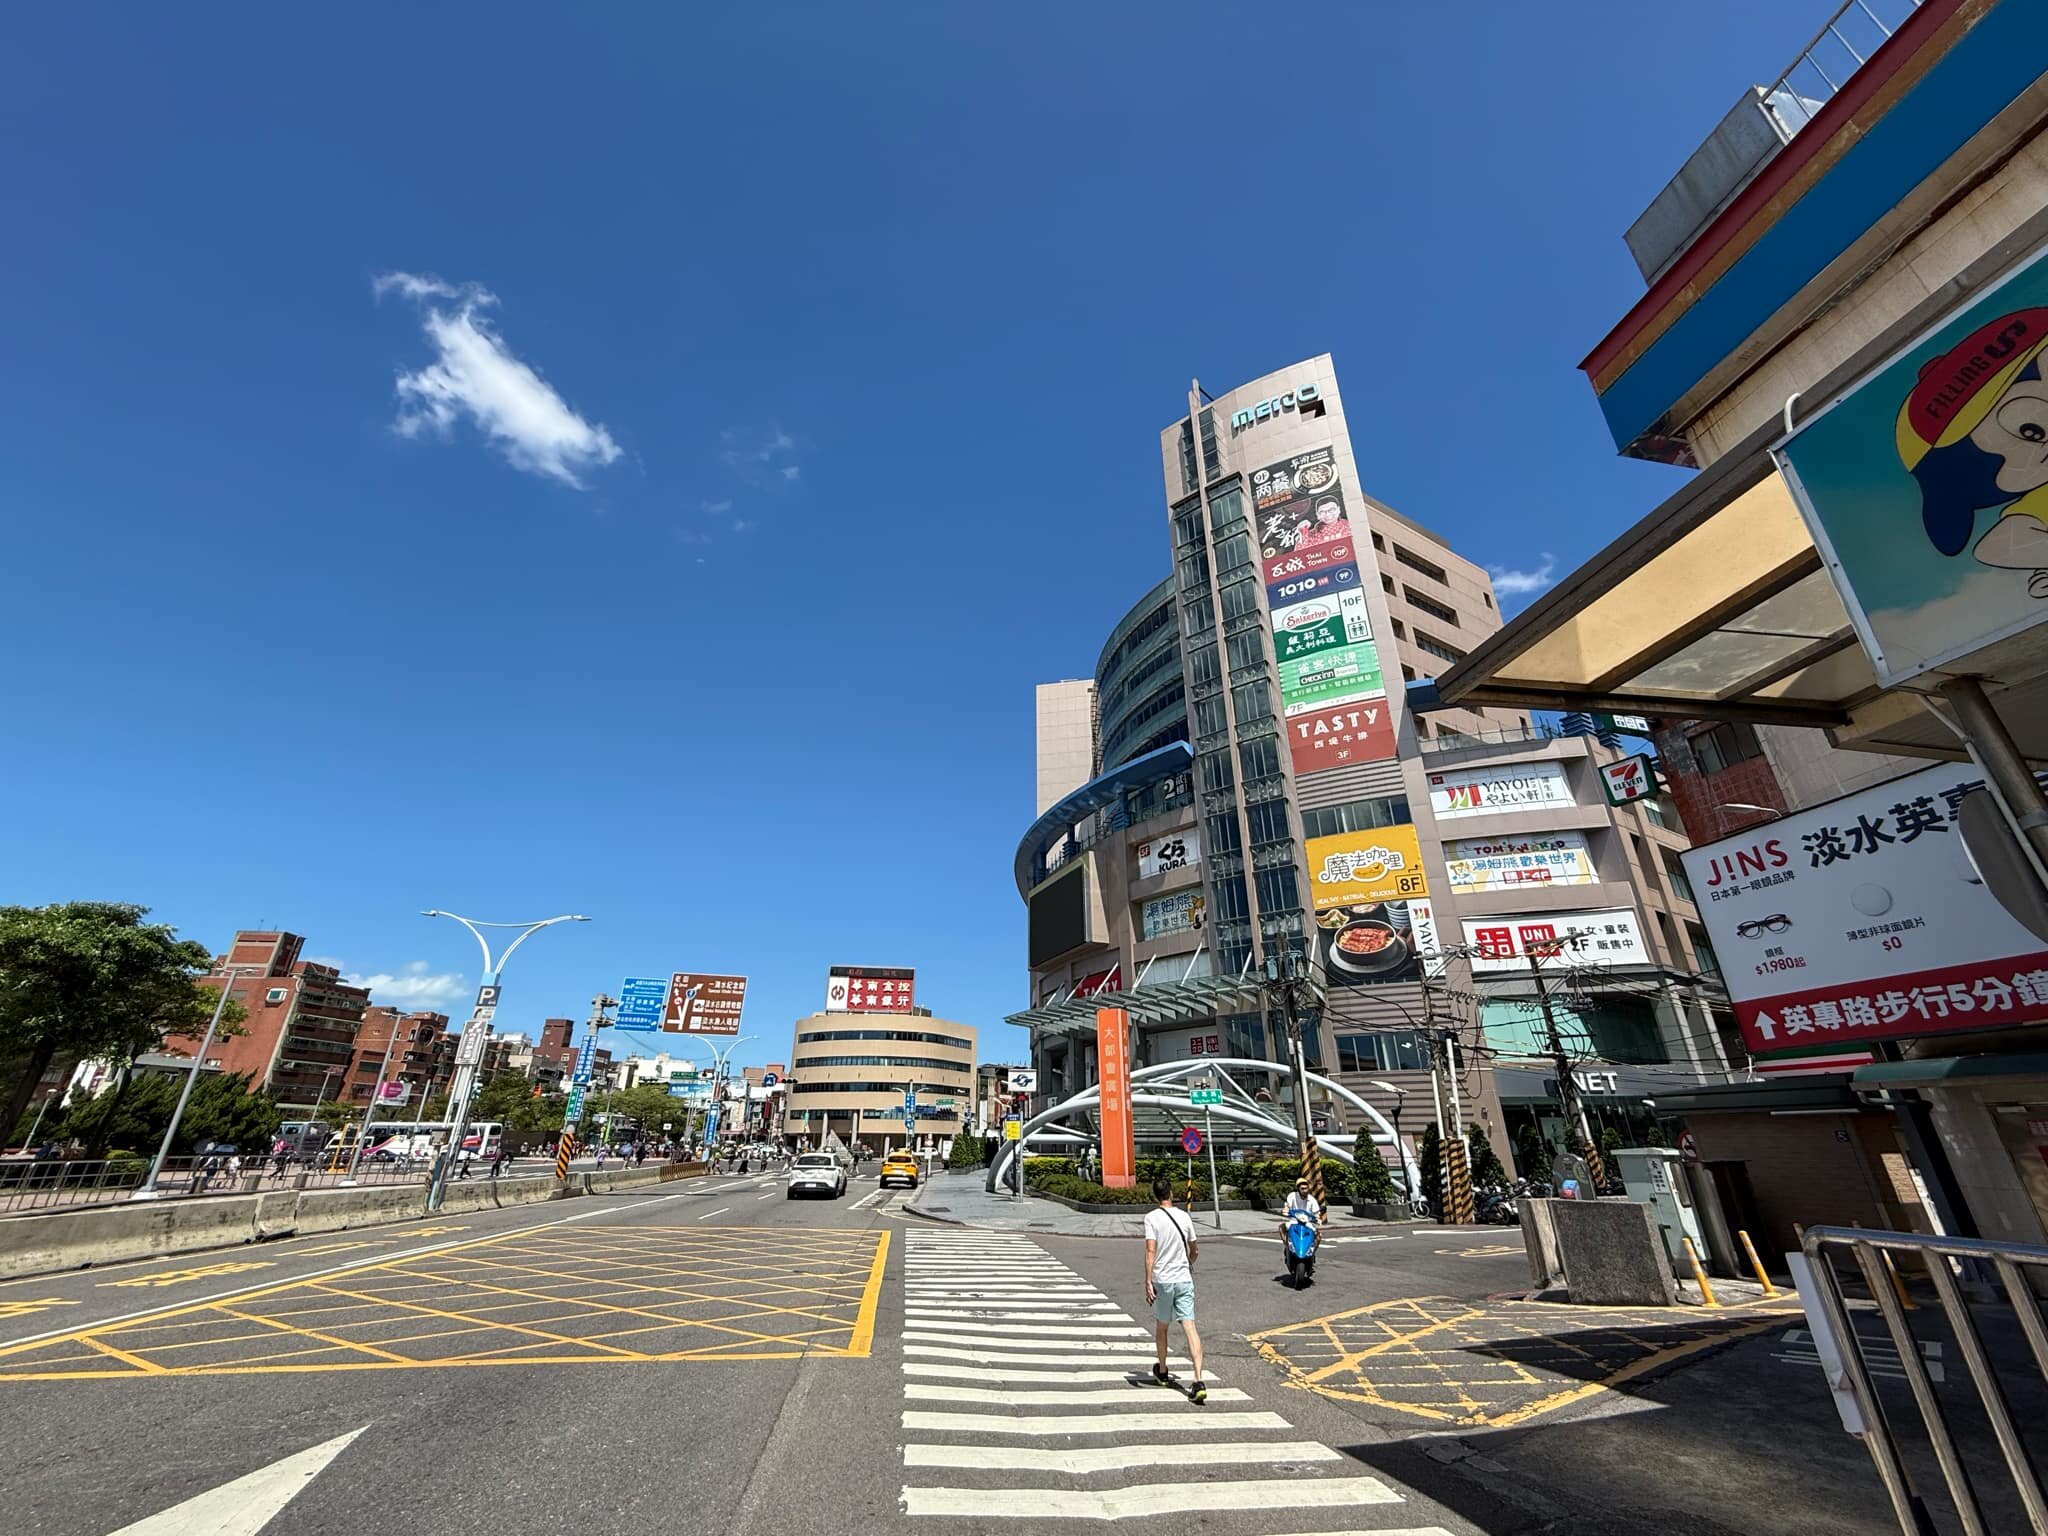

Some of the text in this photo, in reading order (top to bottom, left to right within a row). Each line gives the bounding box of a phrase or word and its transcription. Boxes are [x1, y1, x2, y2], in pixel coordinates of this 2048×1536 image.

[1926, 356, 1991, 418] FILLING
[1277, 577, 1317, 598] 1010
[1342, 595, 1362, 607] 10F
[1286, 610, 1328, 629] Saizeriya
[1290, 703, 1304, 714] 7F
[1297, 708, 1379, 738] TASTY
[1337, 751, 1349, 760] 3F
[1482, 778, 1530, 793] YAYOI
[1486, 789, 1539, 805] やよい軒
[1158, 839, 1186, 861] くら
[1159, 858, 1187, 873] KURA
[1399, 876, 1421, 892] 8F
[1710, 870, 1796, 902] 日本第一眼鏡品牌
[1522, 928, 1550, 941] UNI
[1882, 936, 1903, 951] $0
[1755, 956, 1807, 976] $1,980起
[479, 987, 495, 1005] P
[1780, 969, 2048, 1037] 英專路步行5分鐘
[1570, 1071, 1618, 1091] NET
